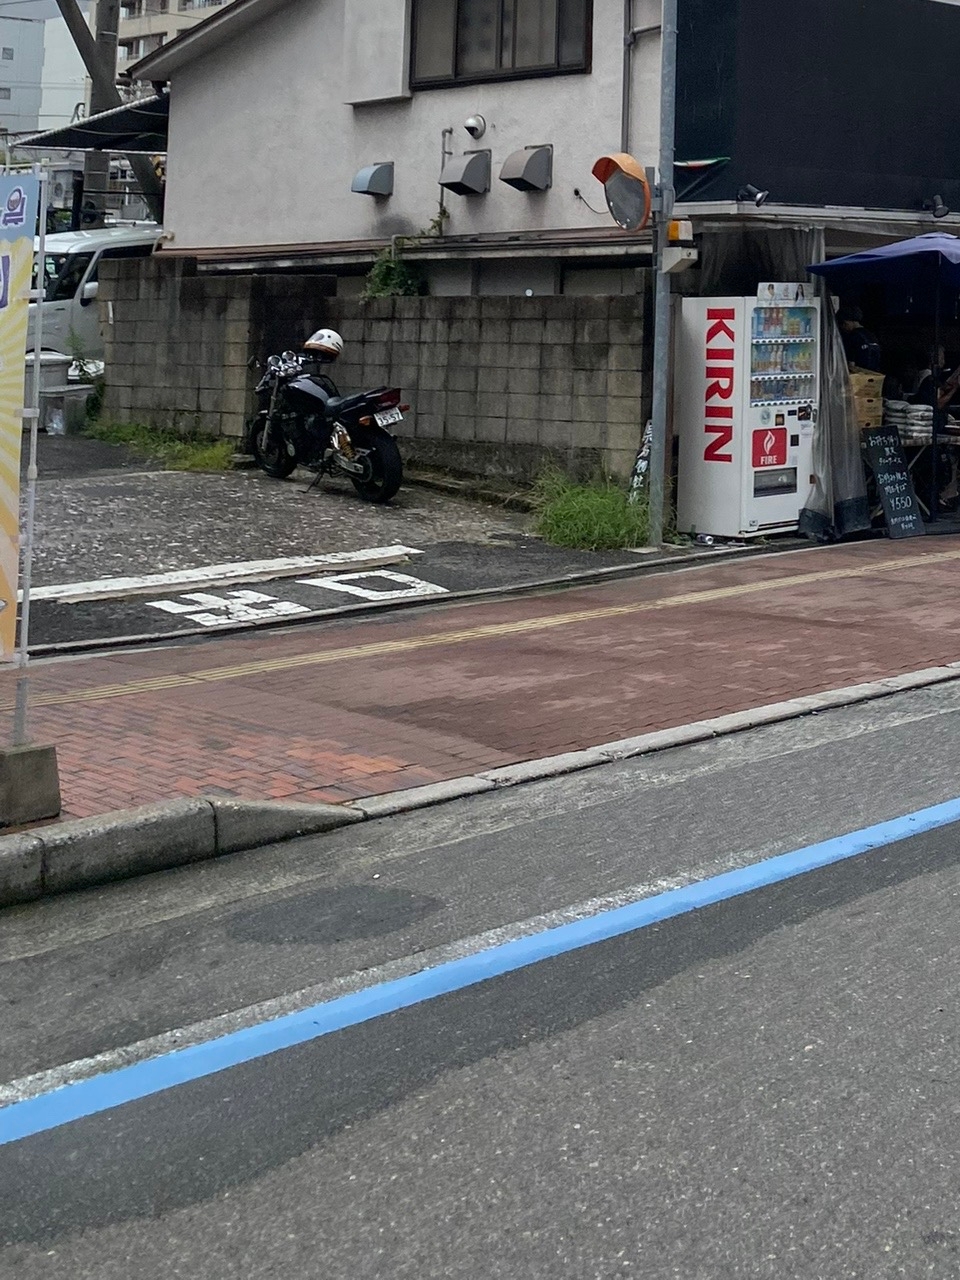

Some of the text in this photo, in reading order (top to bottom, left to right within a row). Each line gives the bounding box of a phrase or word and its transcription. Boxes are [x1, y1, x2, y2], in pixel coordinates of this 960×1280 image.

[703, 307, 735, 463] KIRIN
[759, 455, 778, 466] FIRE
[145, 569, 451, 627] 出口
